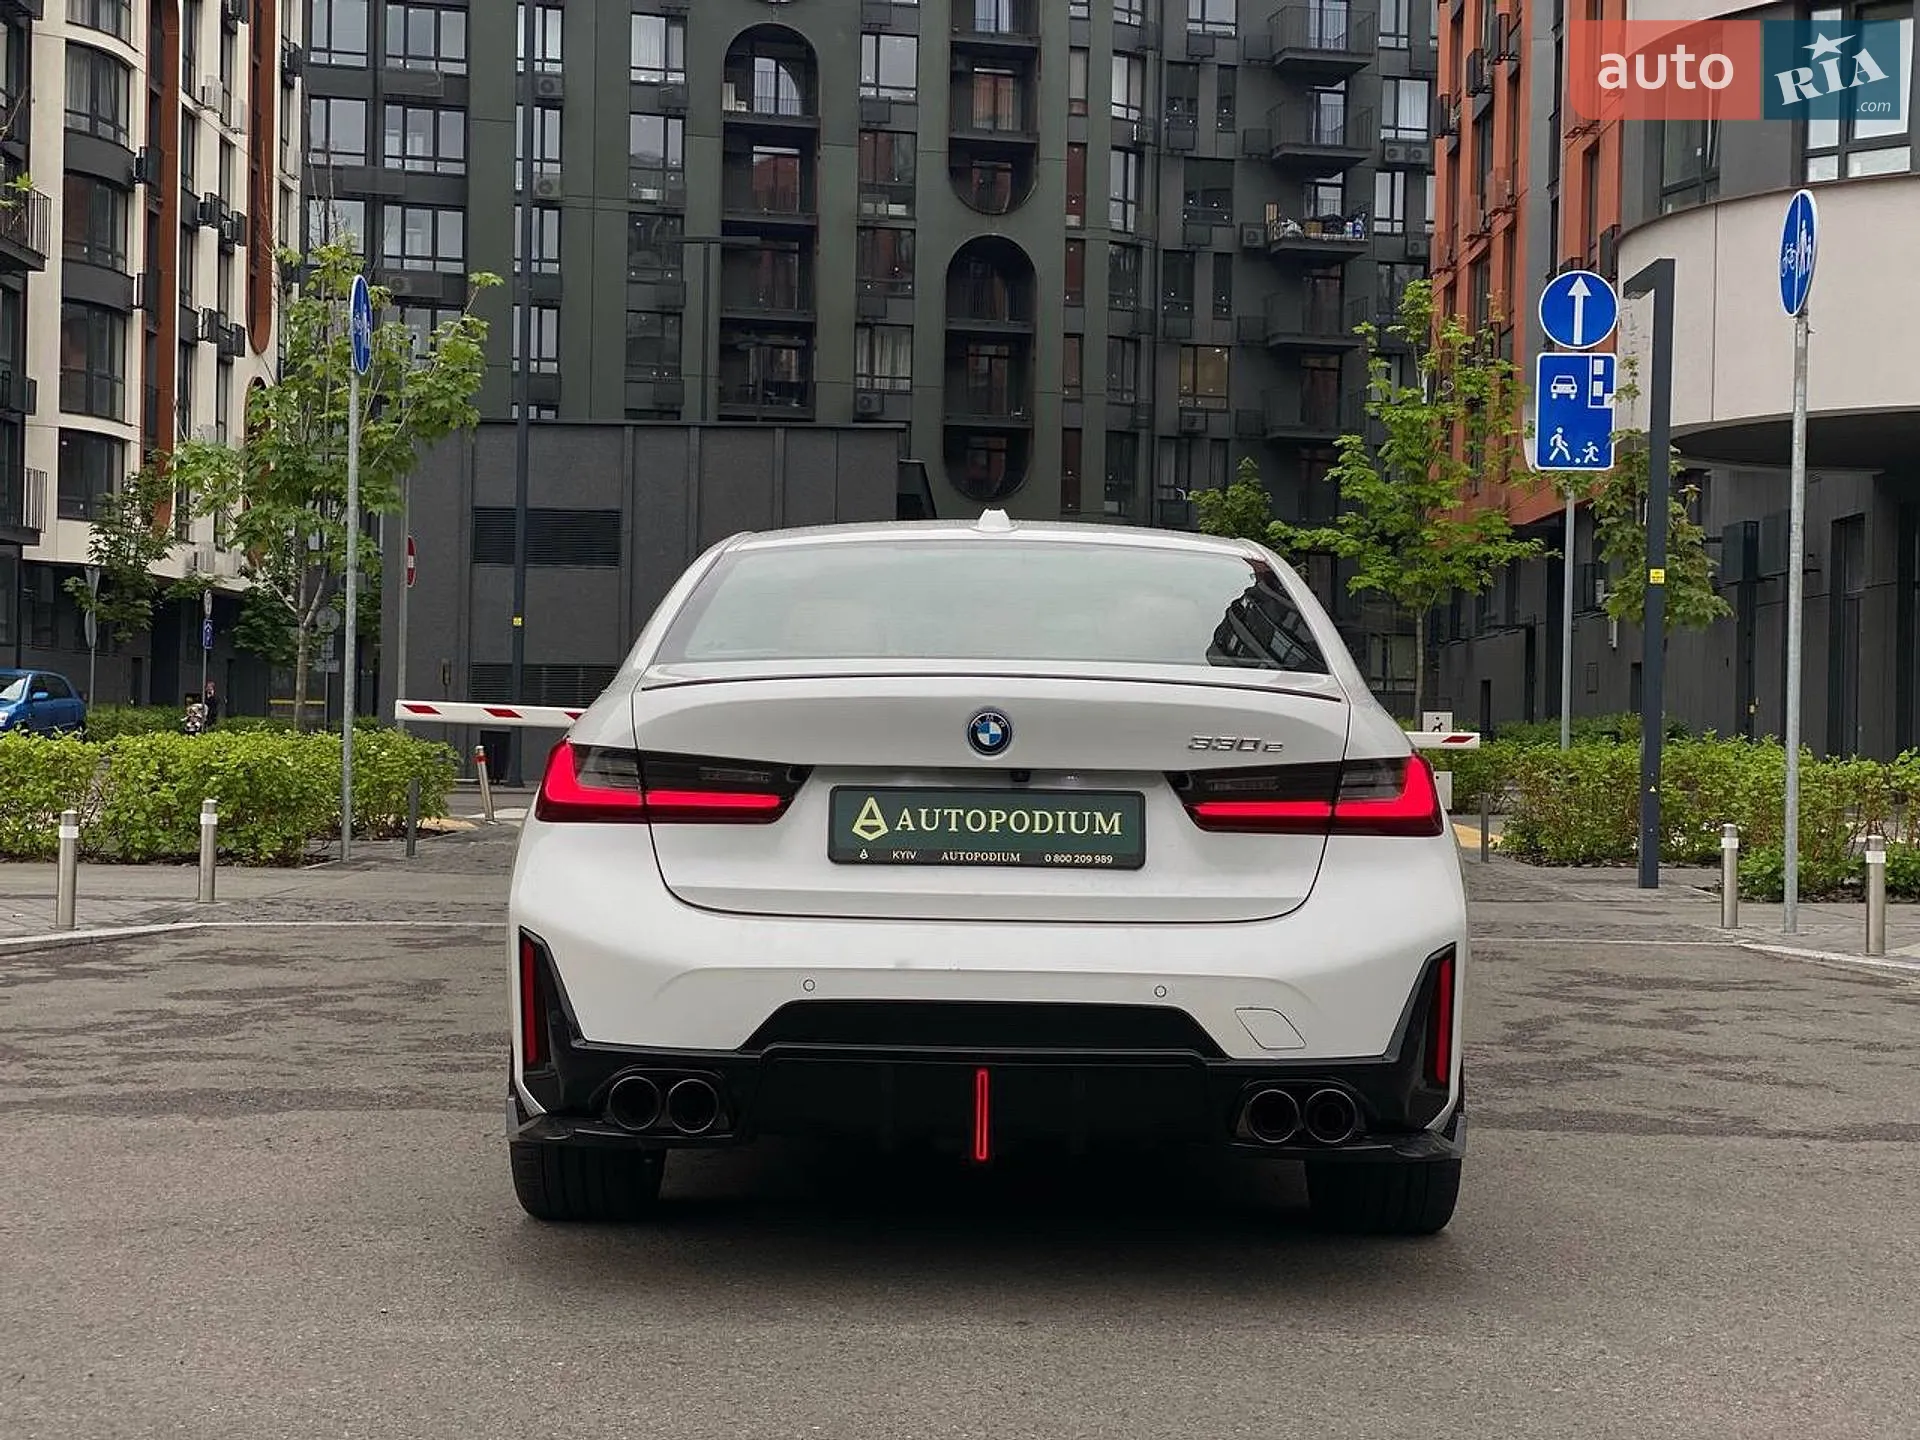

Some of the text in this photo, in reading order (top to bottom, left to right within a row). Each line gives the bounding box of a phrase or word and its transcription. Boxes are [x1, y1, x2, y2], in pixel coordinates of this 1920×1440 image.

[895, 807, 1123, 836] AUTOPODIUM
[892, 849, 1113, 864] KYIV AUTOPODIUM 0 800 209 989
